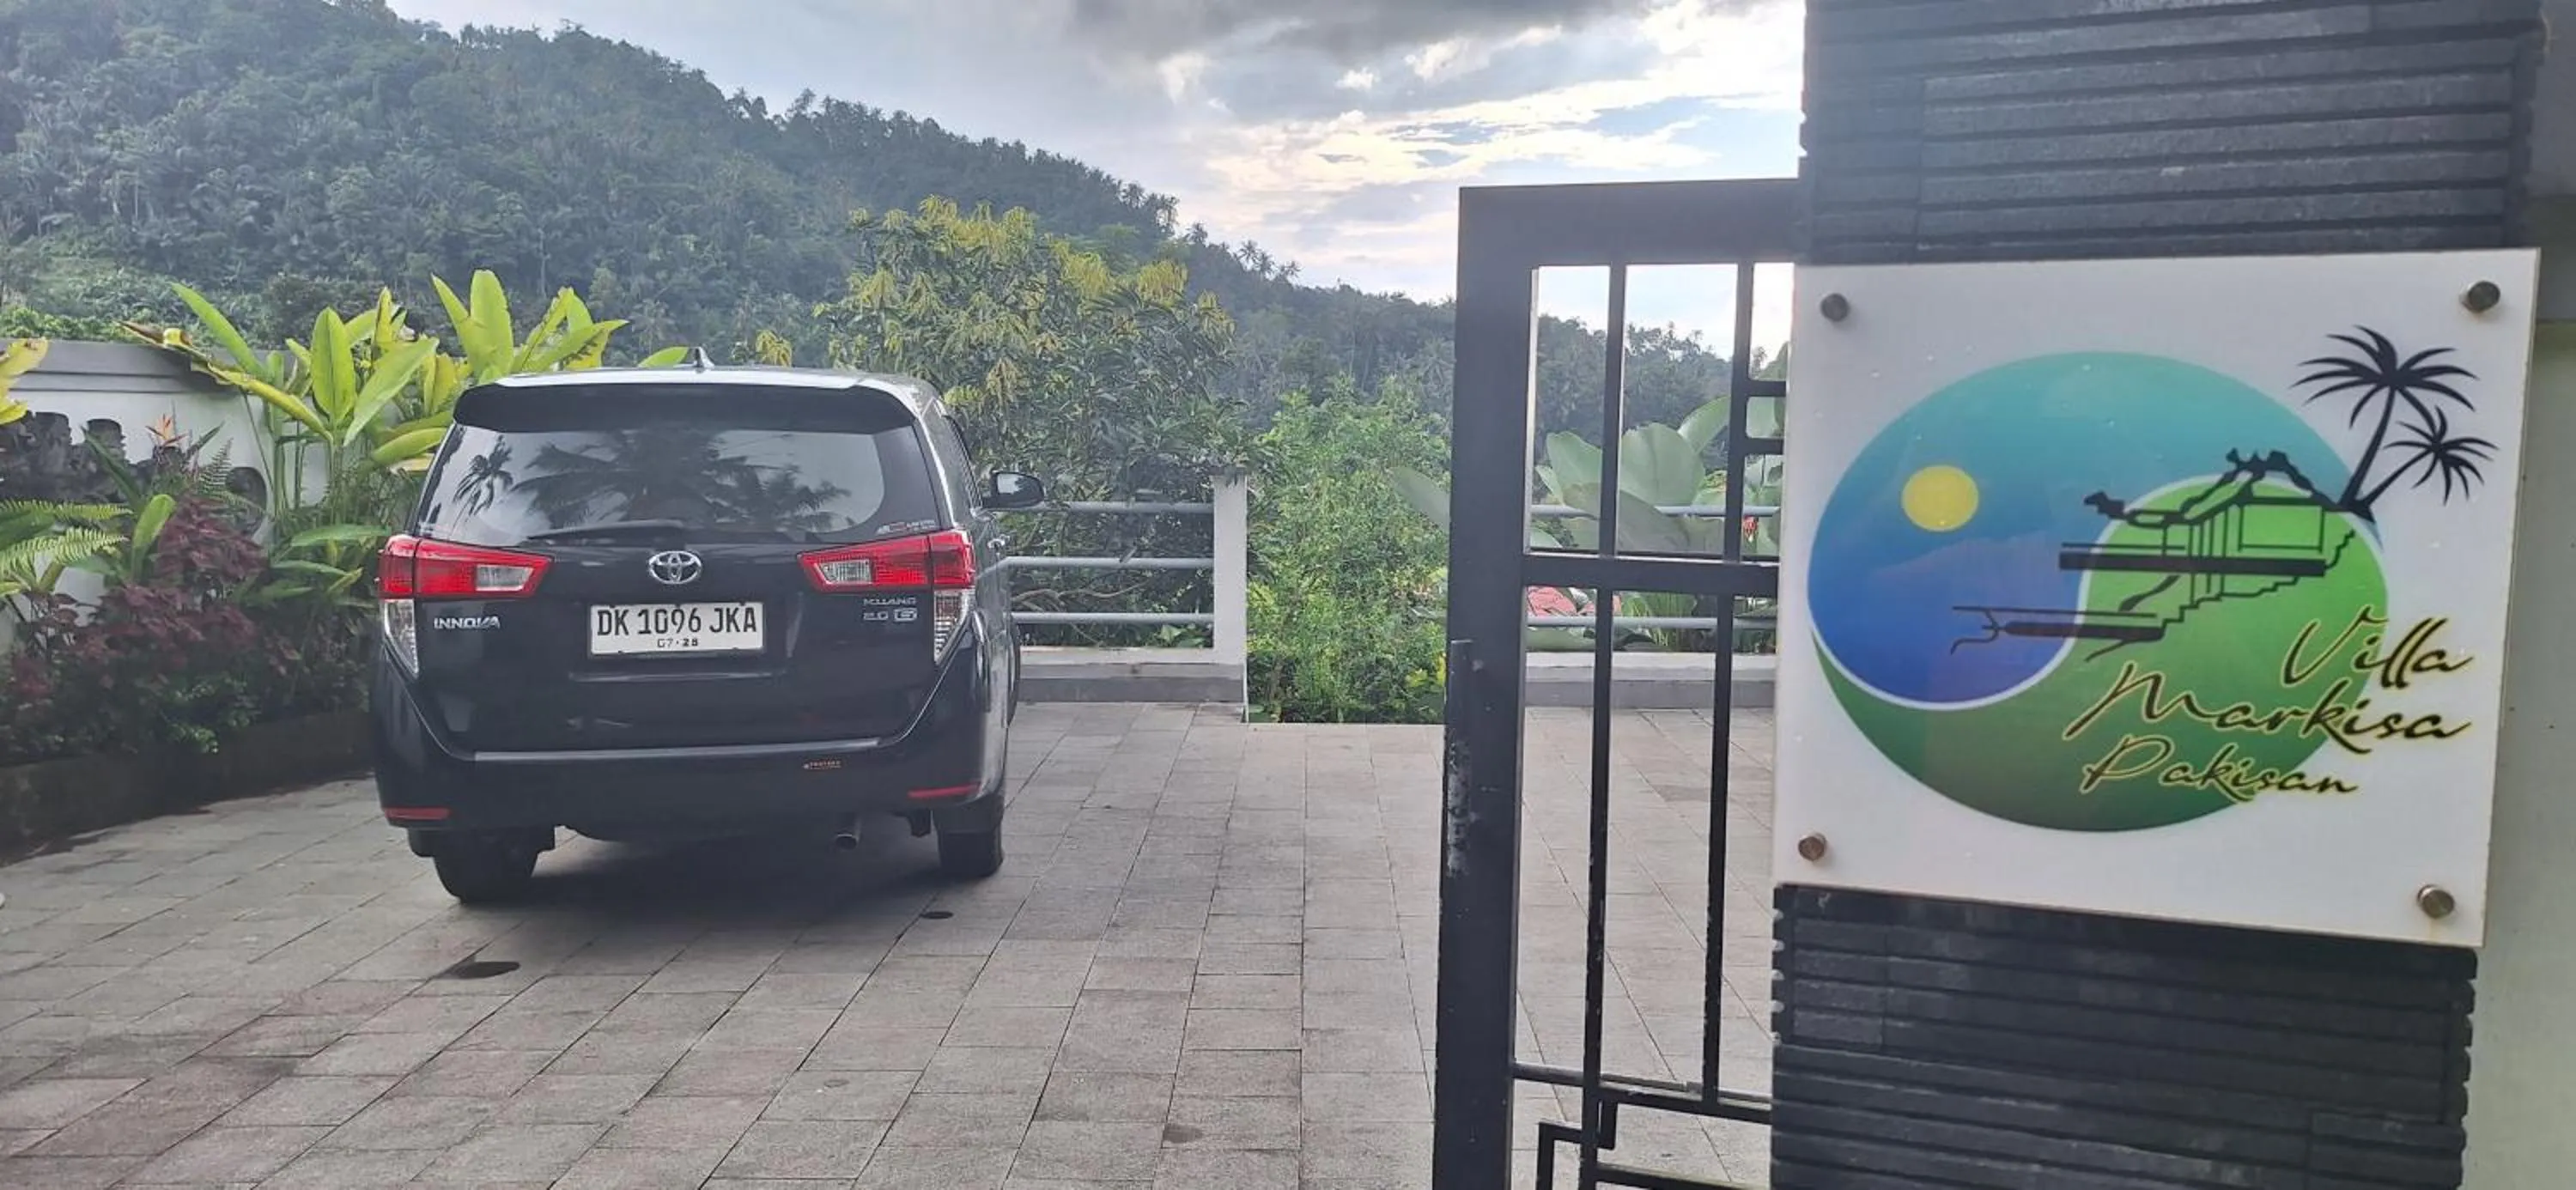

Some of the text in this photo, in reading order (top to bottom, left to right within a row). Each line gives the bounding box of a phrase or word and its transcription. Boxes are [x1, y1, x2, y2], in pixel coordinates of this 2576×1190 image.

[434, 616, 501, 629] INNOVA
[597, 606, 757, 636] DK 1096 JKA
[2282, 604, 2474, 689] Villa
[2063, 661, 2473, 755] Markisa
[2080, 734, 2359, 803] Pakisan
